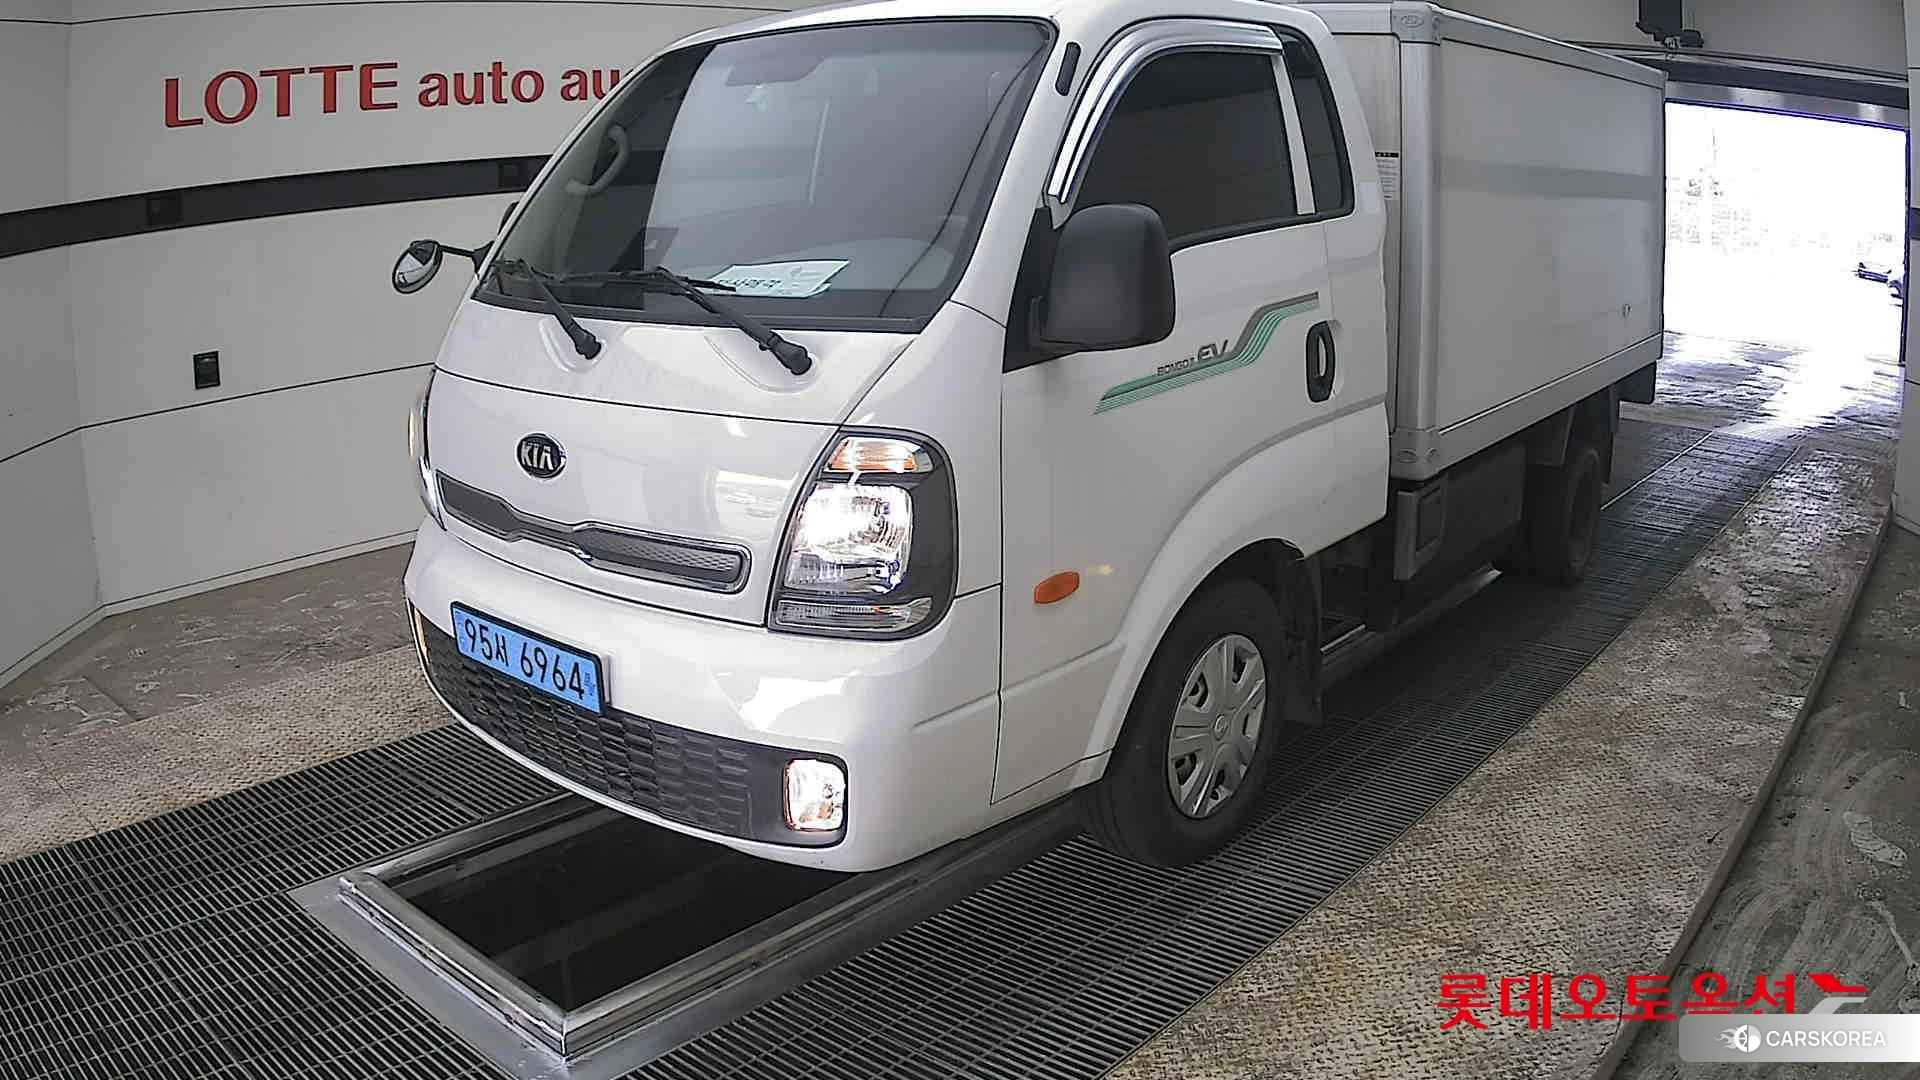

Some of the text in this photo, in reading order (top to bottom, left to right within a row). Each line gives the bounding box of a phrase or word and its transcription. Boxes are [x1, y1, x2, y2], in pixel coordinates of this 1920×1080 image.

[164, 61, 634, 128] LOTTE auto au
[1198, 339, 1229, 361] EV
[521, 440, 554, 471] KIA
[464, 618, 510, 668] 95서
[520, 641, 585, 700] 6964
